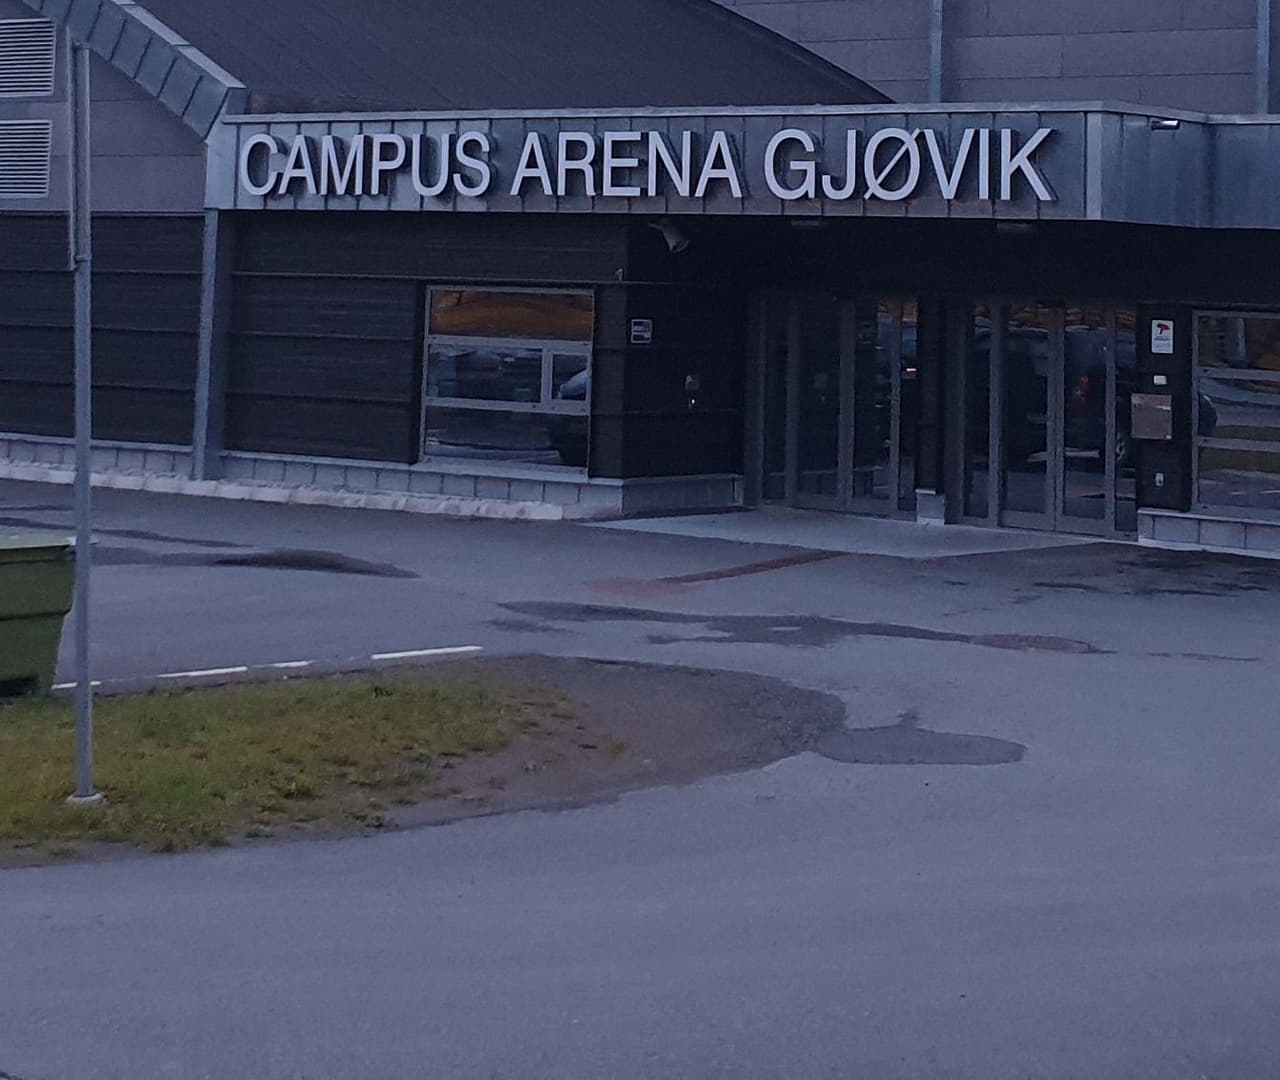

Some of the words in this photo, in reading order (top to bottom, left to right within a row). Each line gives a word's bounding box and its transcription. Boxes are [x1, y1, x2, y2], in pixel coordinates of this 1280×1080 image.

[239, 132, 491, 198] CAMPUS
[511, 131, 743, 199] ARENA
[764, 127, 1054, 201] GJØVIK
